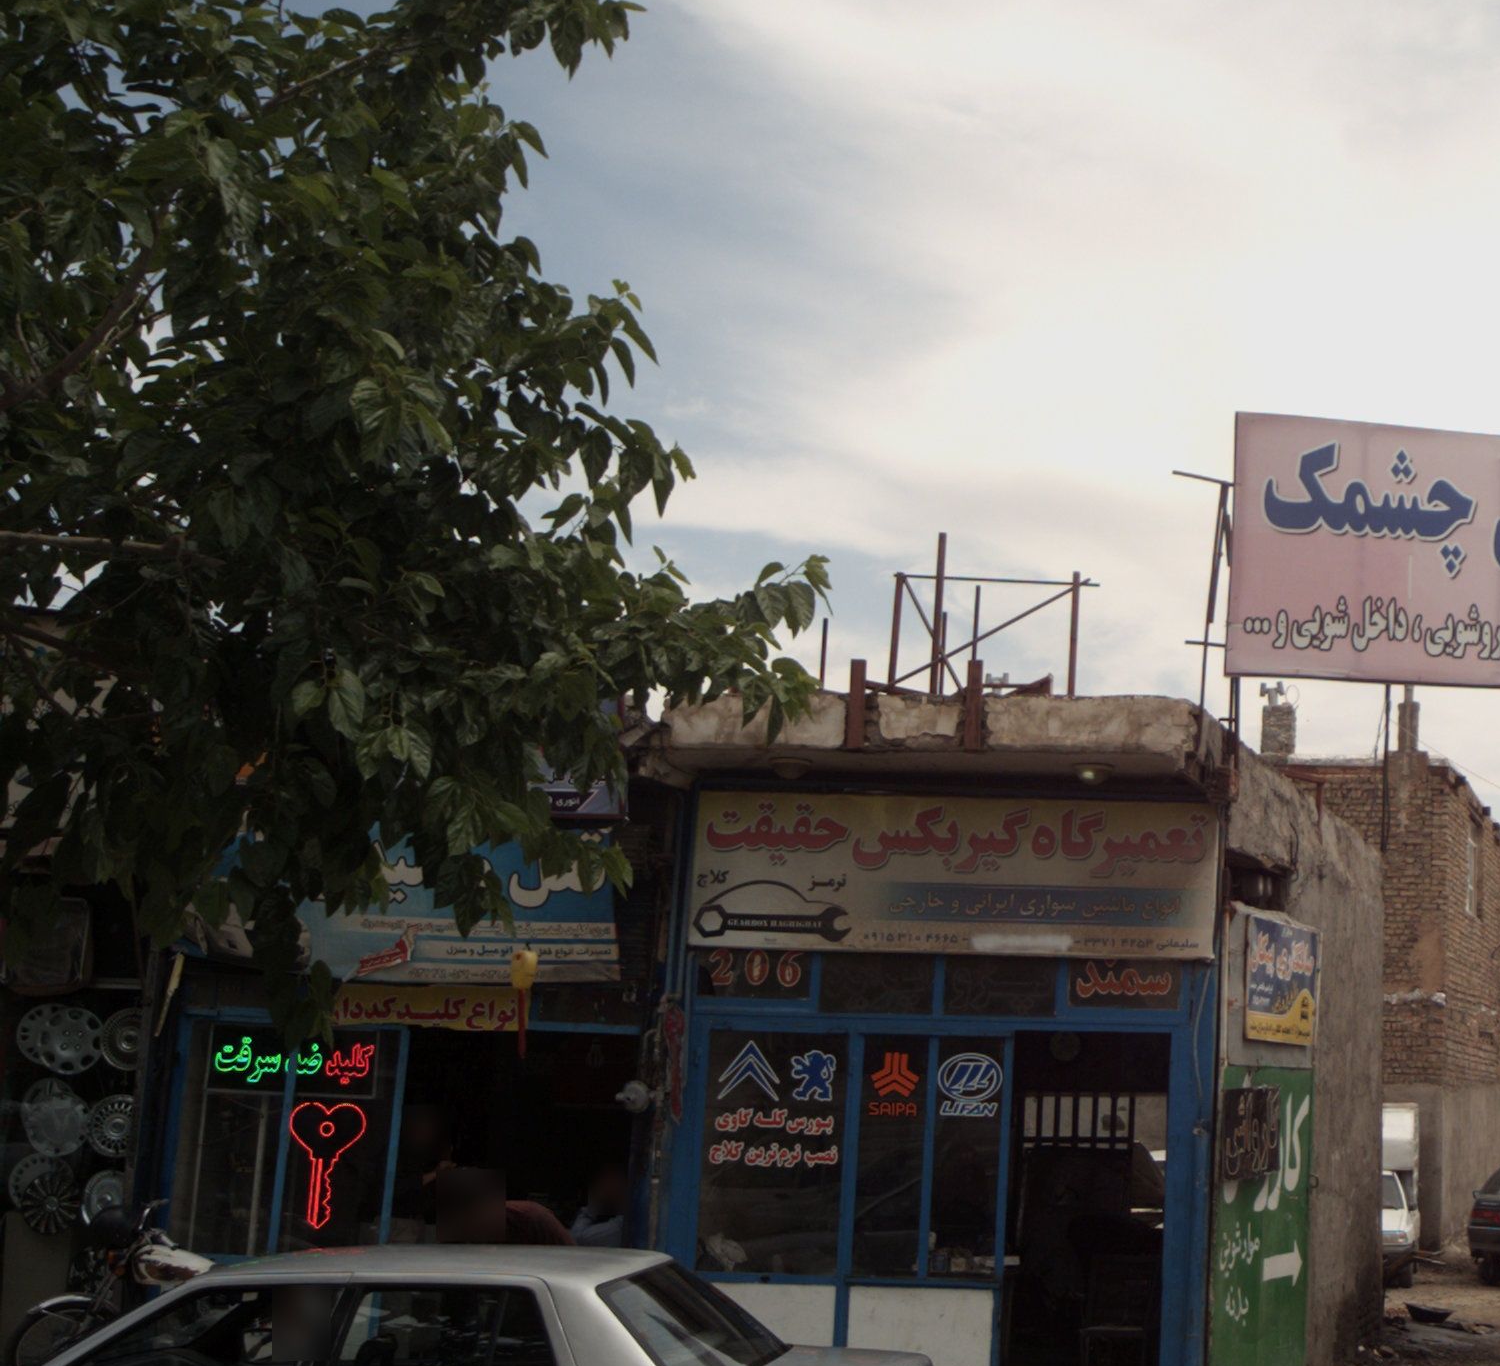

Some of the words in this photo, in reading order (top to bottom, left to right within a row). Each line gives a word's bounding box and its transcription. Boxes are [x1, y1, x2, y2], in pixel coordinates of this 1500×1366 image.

[1263, 442, 1477, 578] چشمک
[1352, 595, 1408, 652] داخل
[707, 802, 851, 866] حقیقت
[1031, 808, 1209, 877] تعمیرگاه
[697, 869, 729, 887] کلاچ
[808, 873, 847, 891] ترمز
[888, 892, 945, 915] خارجی
[964, 893, 1015, 916] ایرانی
[1019, 894, 1076, 918] سواری
[1082, 896, 1136, 919] ماشین
[1141, 896, 1181, 921] انواع
[1075, 959, 1174, 998] سمند
[399, 998, 465, 1027] کلید
[466, 997, 518, 1031] نواع
[215, 1036, 282, 1083] سرقت
[326, 1042, 375, 1085] کلید
[868, 1102, 917, 1117] SAIPA
[940, 1100, 999, 1117] LIFAN
[786, 1115, 834, 1135] بورس
[709, 1140, 744, 1164] کلاچ
[804, 1145, 838, 1167] نصب
